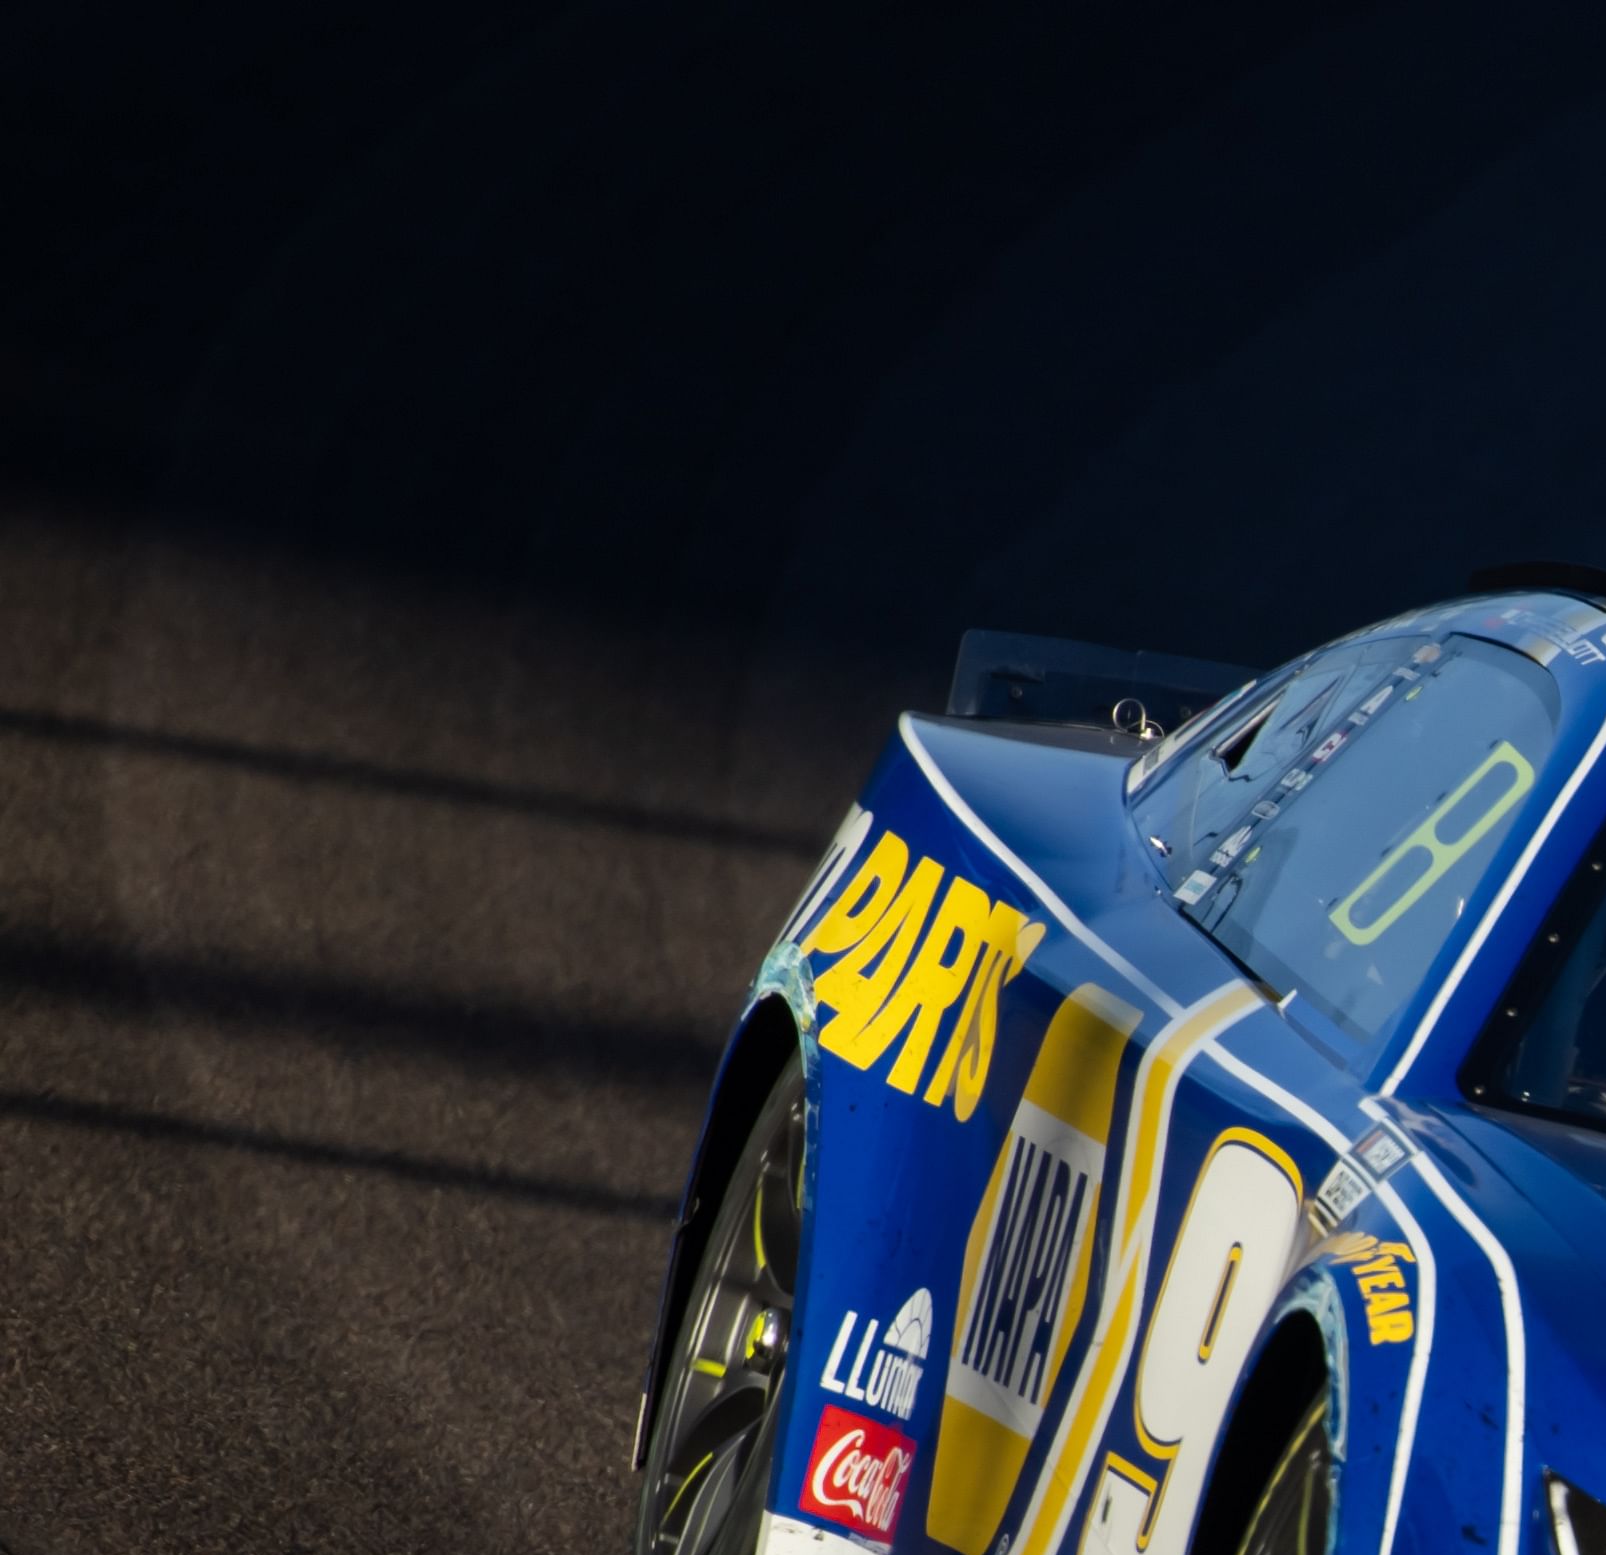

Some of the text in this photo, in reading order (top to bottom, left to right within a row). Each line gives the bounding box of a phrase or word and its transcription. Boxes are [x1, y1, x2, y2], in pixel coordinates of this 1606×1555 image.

[799, 829, 1047, 1123] PARTS
[961, 1134, 1089, 1405] NAPA
[1320, 1230, 1418, 1346] YEAR
